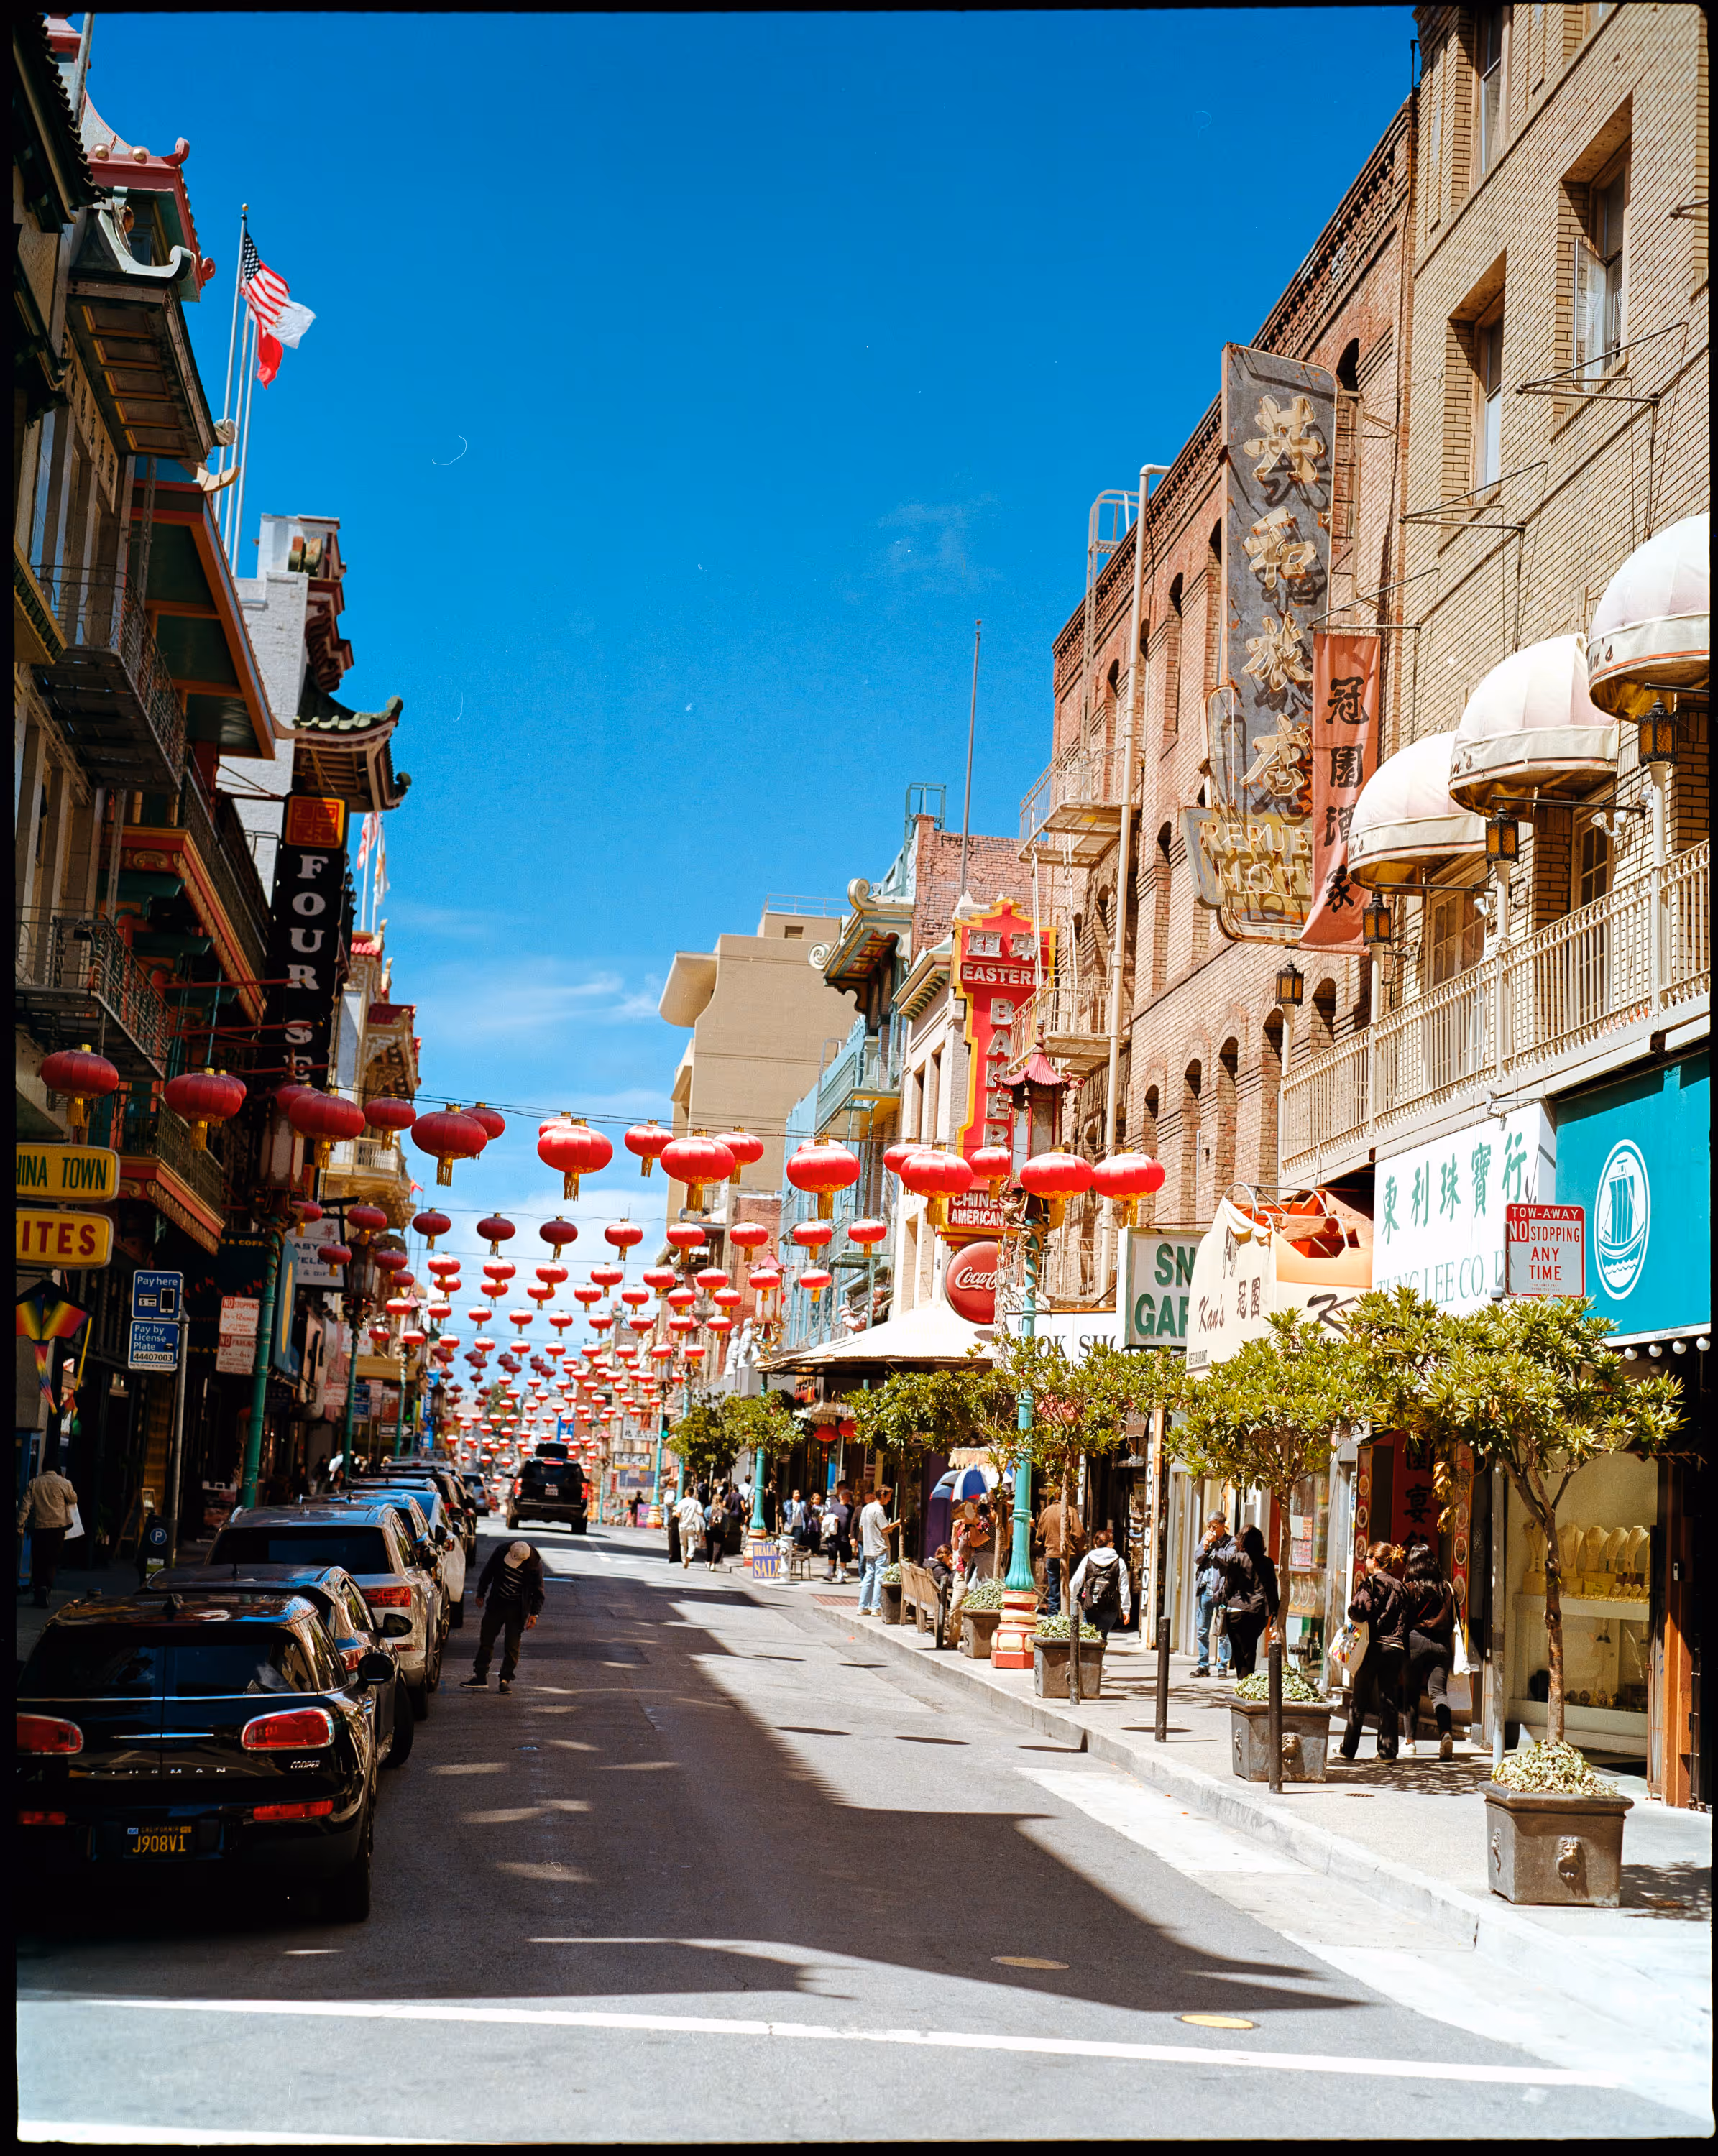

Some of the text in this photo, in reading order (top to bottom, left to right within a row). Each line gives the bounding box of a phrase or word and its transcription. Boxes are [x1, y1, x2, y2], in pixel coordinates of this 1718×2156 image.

[1241, 395, 1323, 796] 共和旅店
[1214, 860, 1313, 898] HOT
[288, 854, 329, 990] FOUR
[62, 1157, 107, 1190] TOWN
[1382, 1132, 1527, 1245] 東利珠寶行
[951, 1209, 1004, 1227] AMERICAN
[1512, 1207, 1579, 1220] TOW-AWAY
[16, 1220, 96, 1256] ITES
[1509, 1220, 1580, 1243] NO STOPPING
[294, 1242, 320, 1250] ASY
[1531, 1246, 1560, 1262] ANY
[137, 1276, 178, 1287] Pay here
[1423, 1261, 1455, 1304] LEE
[1459, 1254, 1488, 1299] CO.
[1529, 1265, 1562, 1280] TIME
[134, 1325, 165, 1335] Pay by
[134, 1334, 167, 1342] License
[133, 1342, 156, 1350] Plate
[1079, 1335, 1116, 1358] SH
[134, 1353, 173, 1362] 44407003
[290, 1760, 321, 1769] COOPER
[132, 1835, 186, 1853] J908V1
